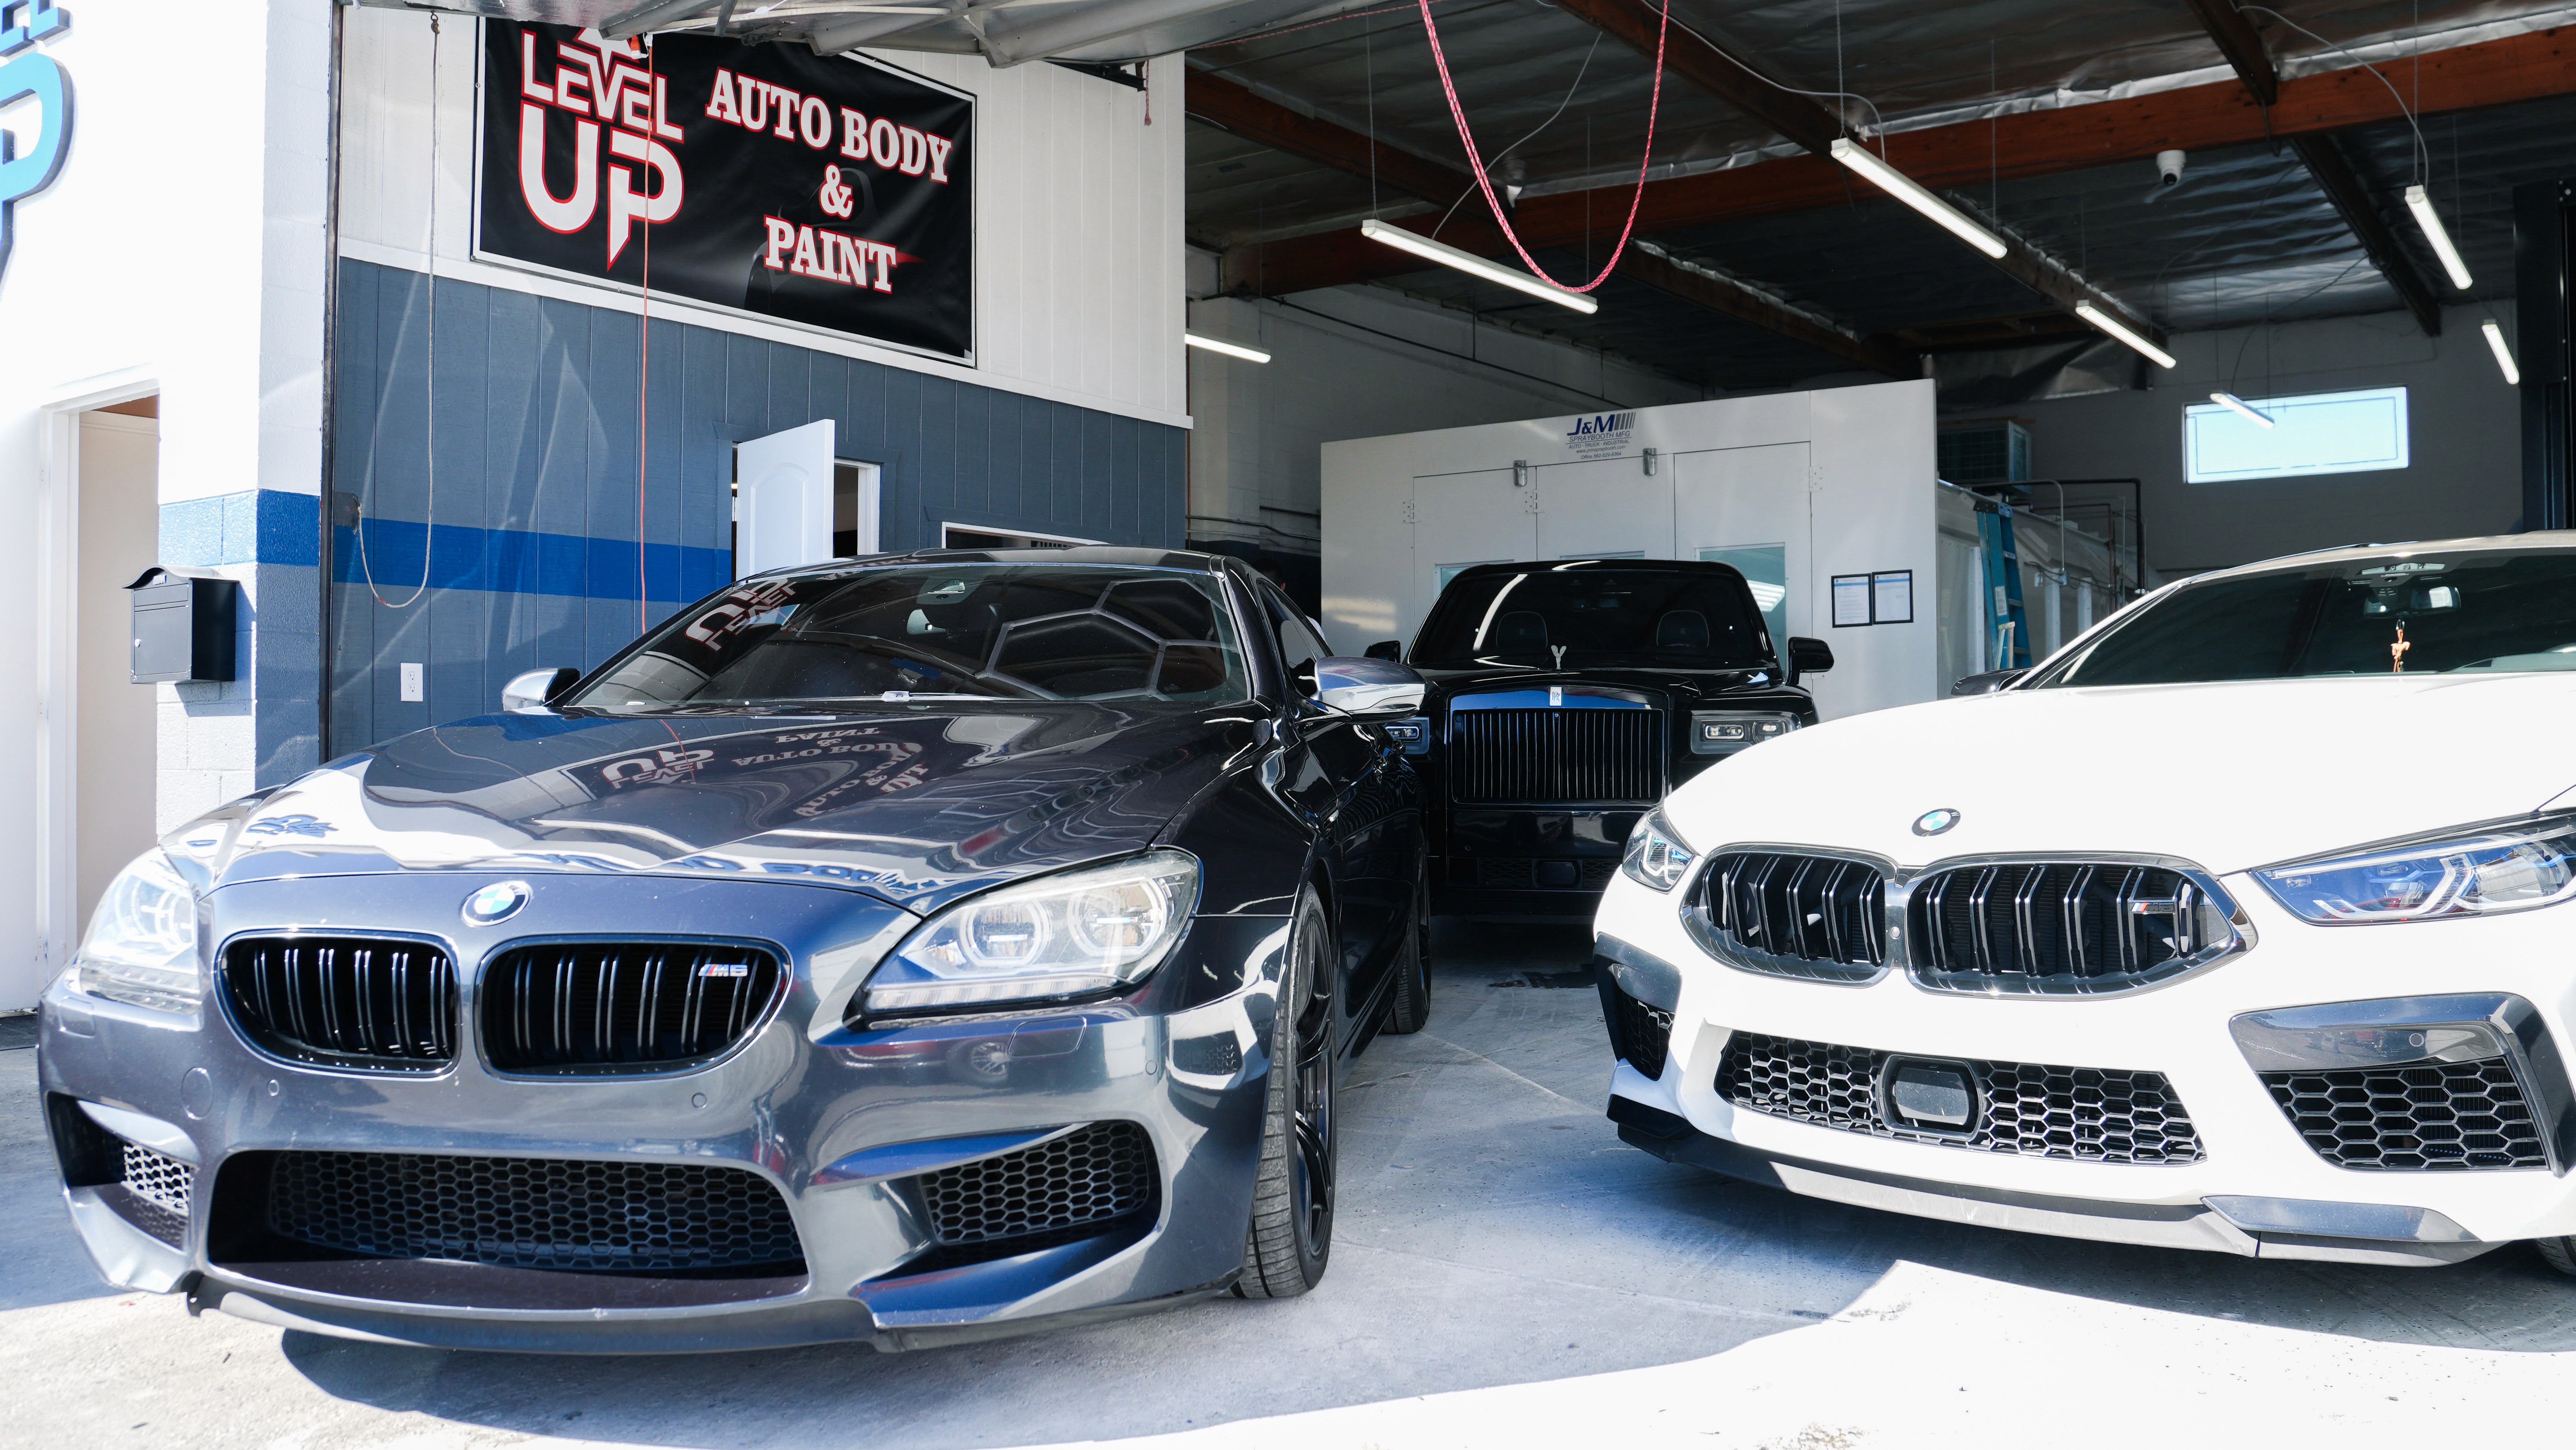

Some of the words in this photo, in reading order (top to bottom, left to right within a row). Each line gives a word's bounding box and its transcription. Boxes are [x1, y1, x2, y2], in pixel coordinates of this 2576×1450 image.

[522, 28, 684, 143] LEVEL
[705, 66, 833, 150] AUTO
[840, 105, 952, 184] BODY
[519, 99, 684, 271] UP
[818, 163, 853, 220] &
[763, 214, 897, 294] PAINT
[1567, 414, 1615, 436] J&M
[1569, 433, 1614, 442] SPRAYBOOTH
